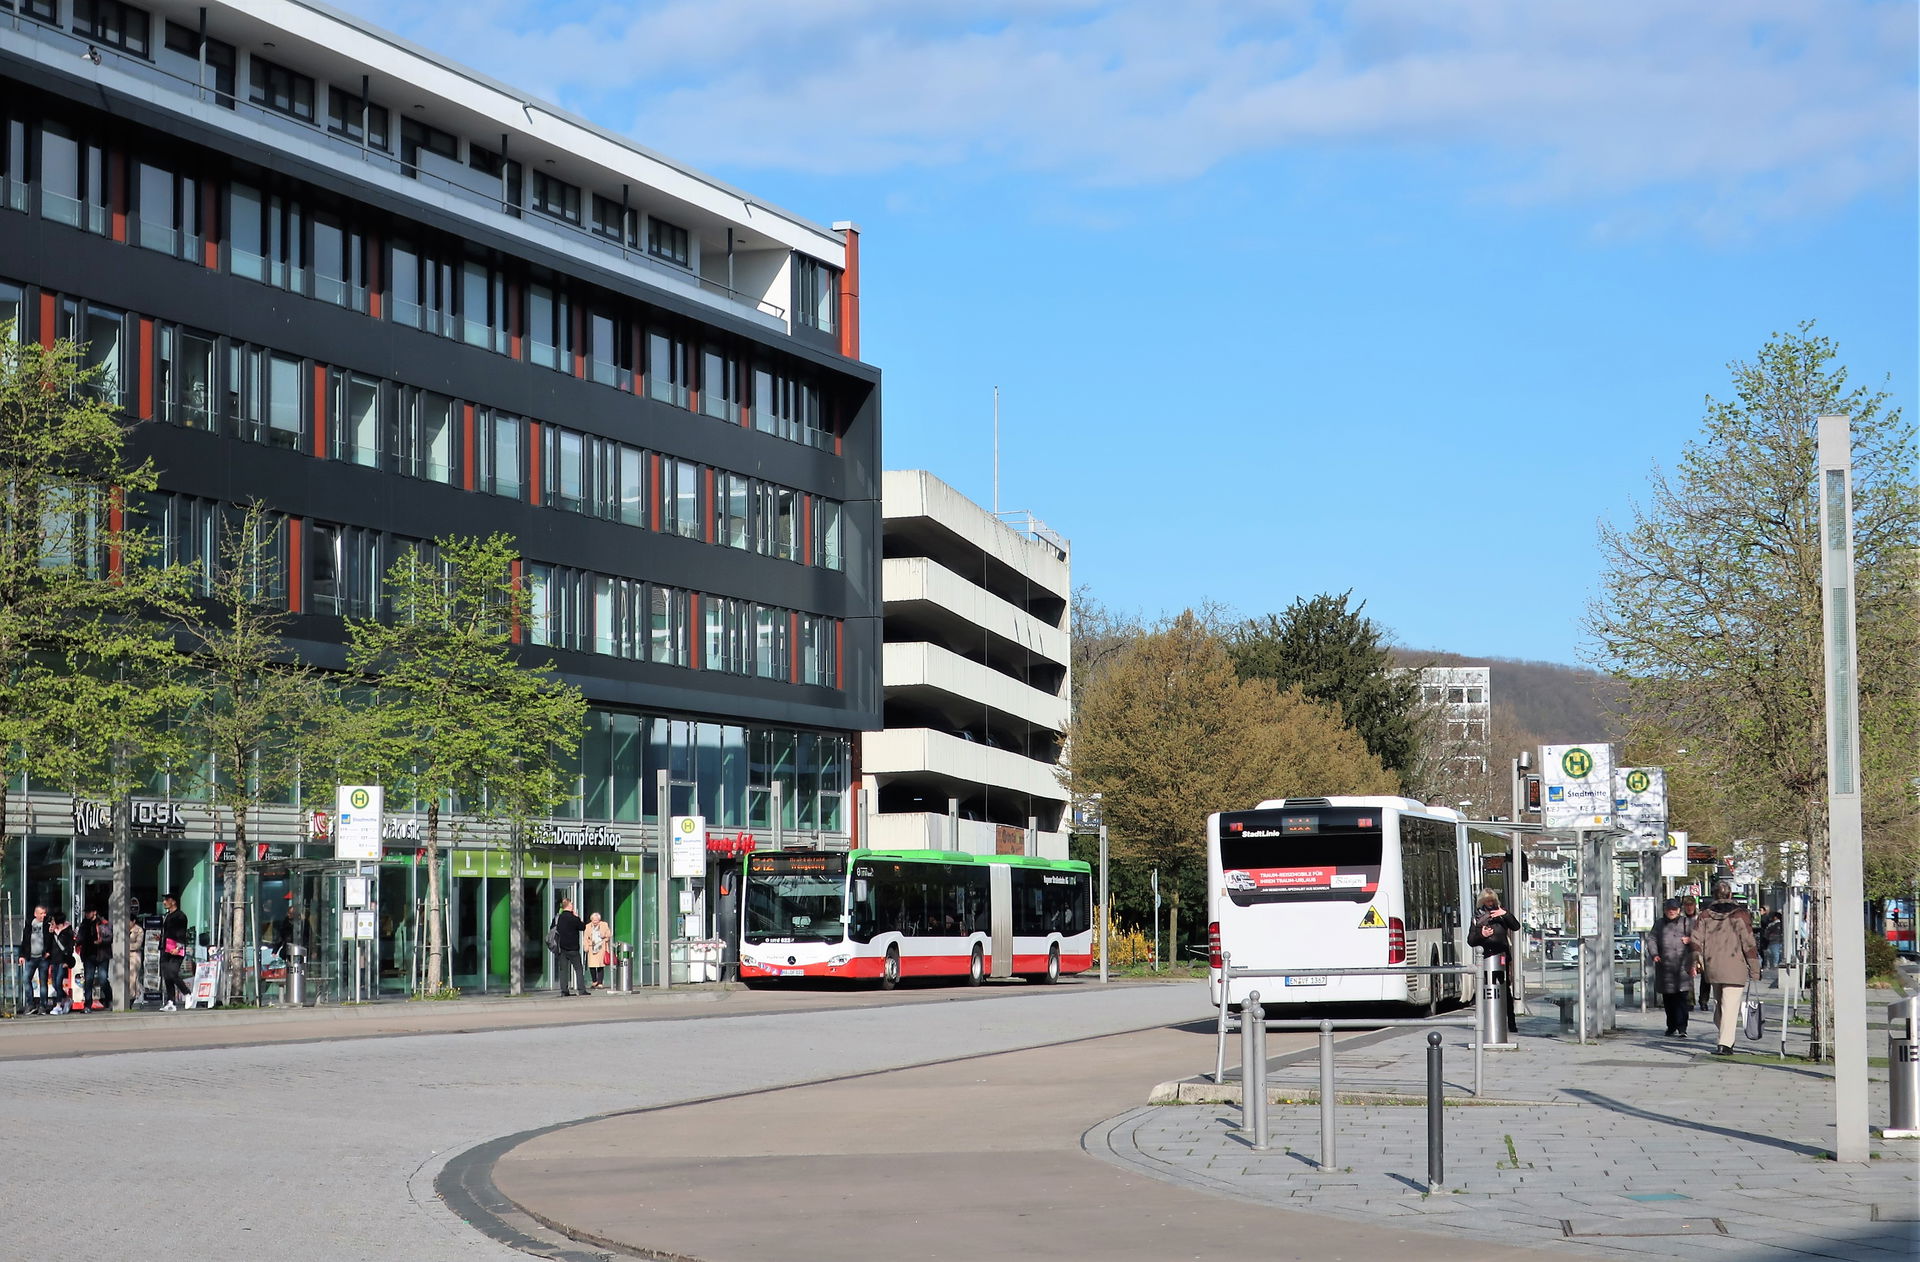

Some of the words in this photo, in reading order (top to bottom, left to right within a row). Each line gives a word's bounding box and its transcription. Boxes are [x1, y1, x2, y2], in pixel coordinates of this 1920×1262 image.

[1567, 789, 1607, 798] Stadtmitte
[131, 802, 185, 825] IOSK
[1242, 830, 1280, 838] StadtLinie
